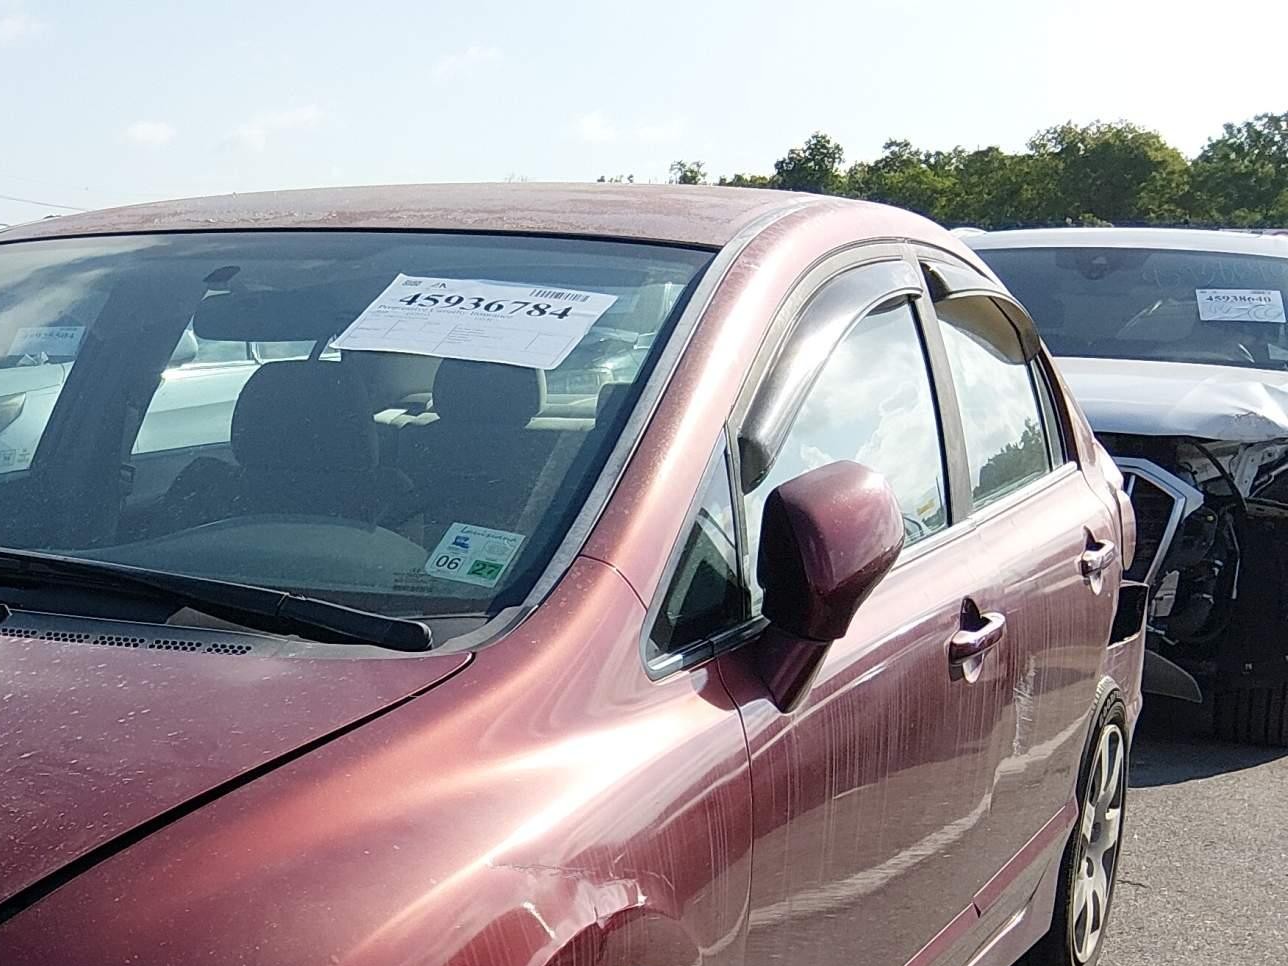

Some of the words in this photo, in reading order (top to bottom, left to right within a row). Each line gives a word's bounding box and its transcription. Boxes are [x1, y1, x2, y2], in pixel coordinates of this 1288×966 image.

[398, 291, 573, 321] 45936784
[435, 555, 462, 570] 06
[471, 562, 499, 577] 27
